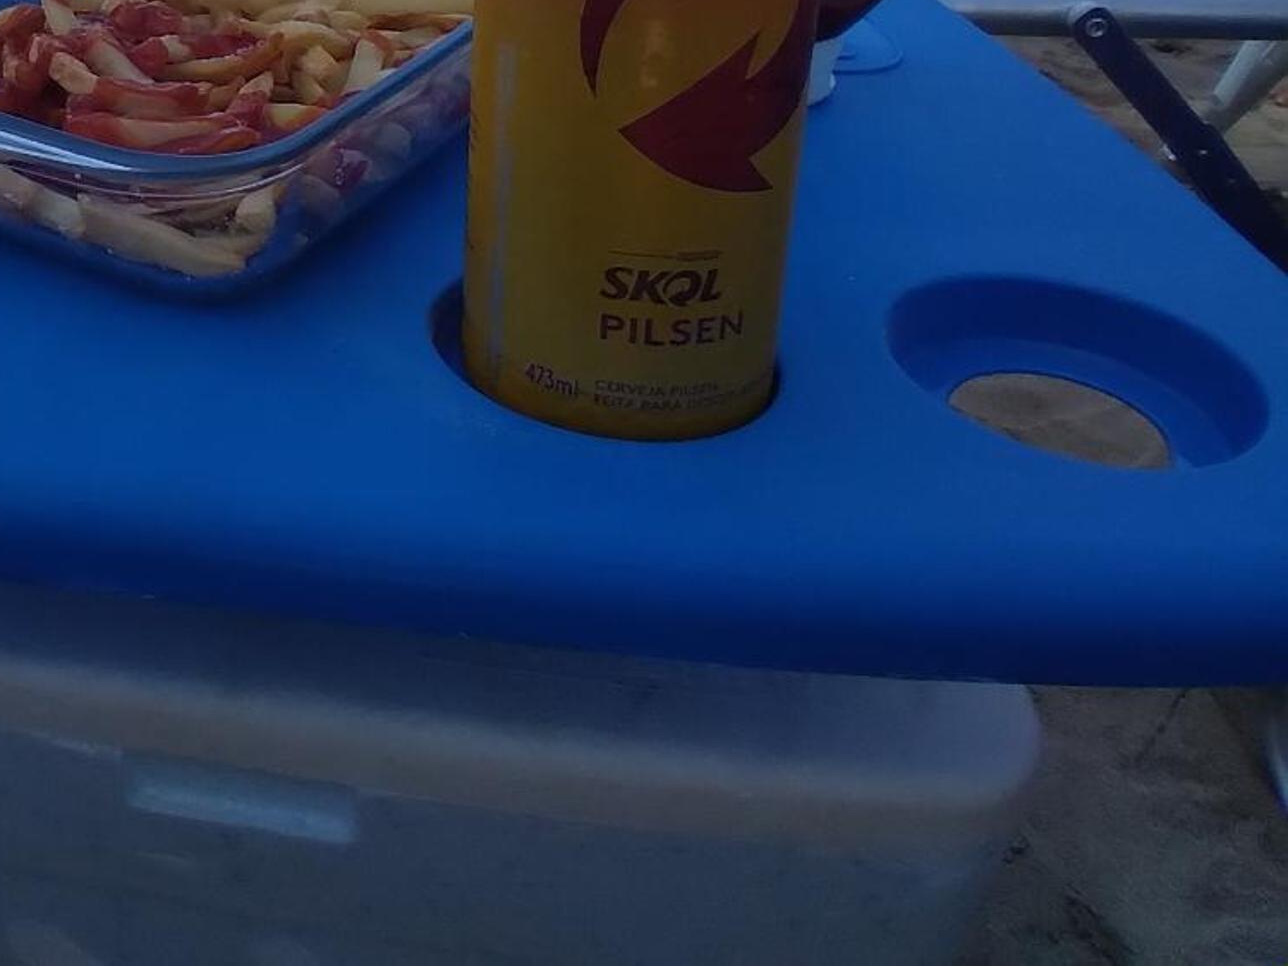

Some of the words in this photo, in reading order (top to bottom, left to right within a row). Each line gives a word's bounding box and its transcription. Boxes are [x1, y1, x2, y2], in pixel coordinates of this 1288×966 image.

[599, 266, 723, 307] SKOL
[599, 310, 744, 346] PILSEN
[524, 363, 579, 397] 473ml
